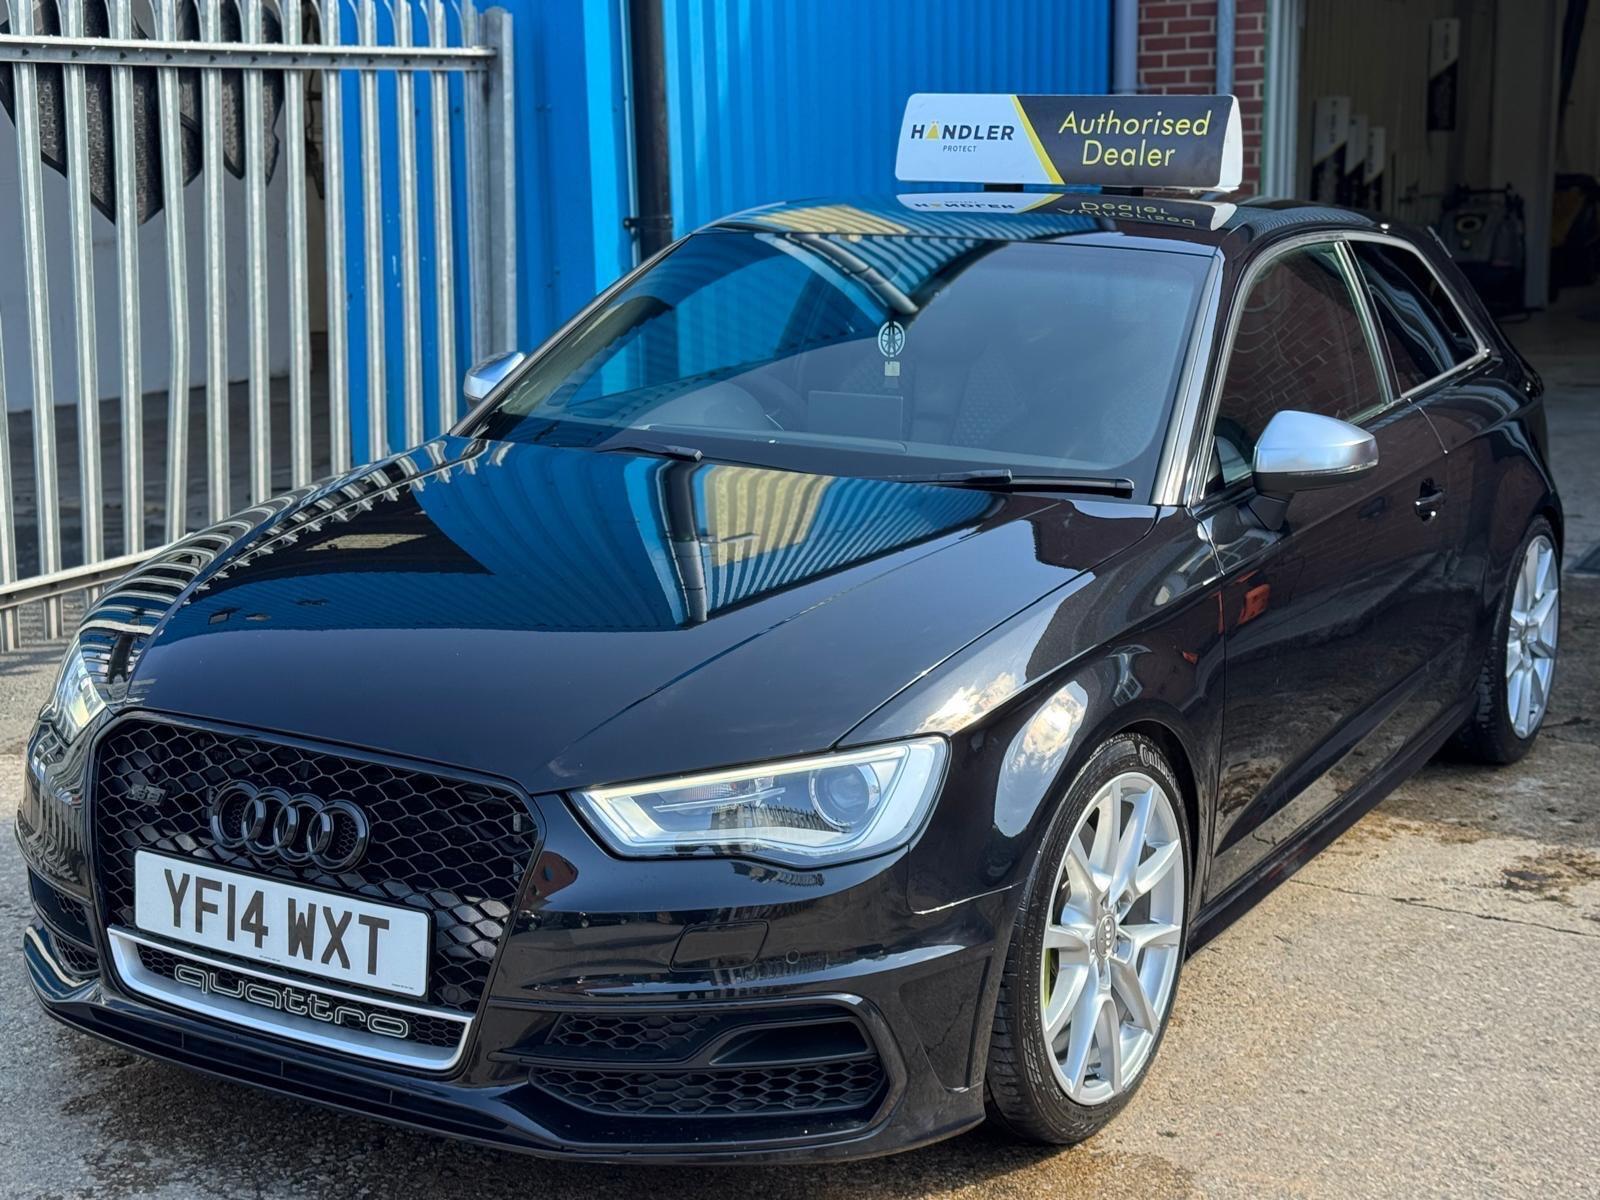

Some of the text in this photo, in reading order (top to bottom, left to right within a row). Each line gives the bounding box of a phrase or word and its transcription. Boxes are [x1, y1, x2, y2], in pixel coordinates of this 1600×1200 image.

[1059, 110, 1212, 136] Authorised
[942, 144, 977, 153] PROTECT
[1081, 139, 1176, 168] Dealer
[164, 869, 390, 976] YF14 WXT
[174, 964, 409, 1038] quattro
